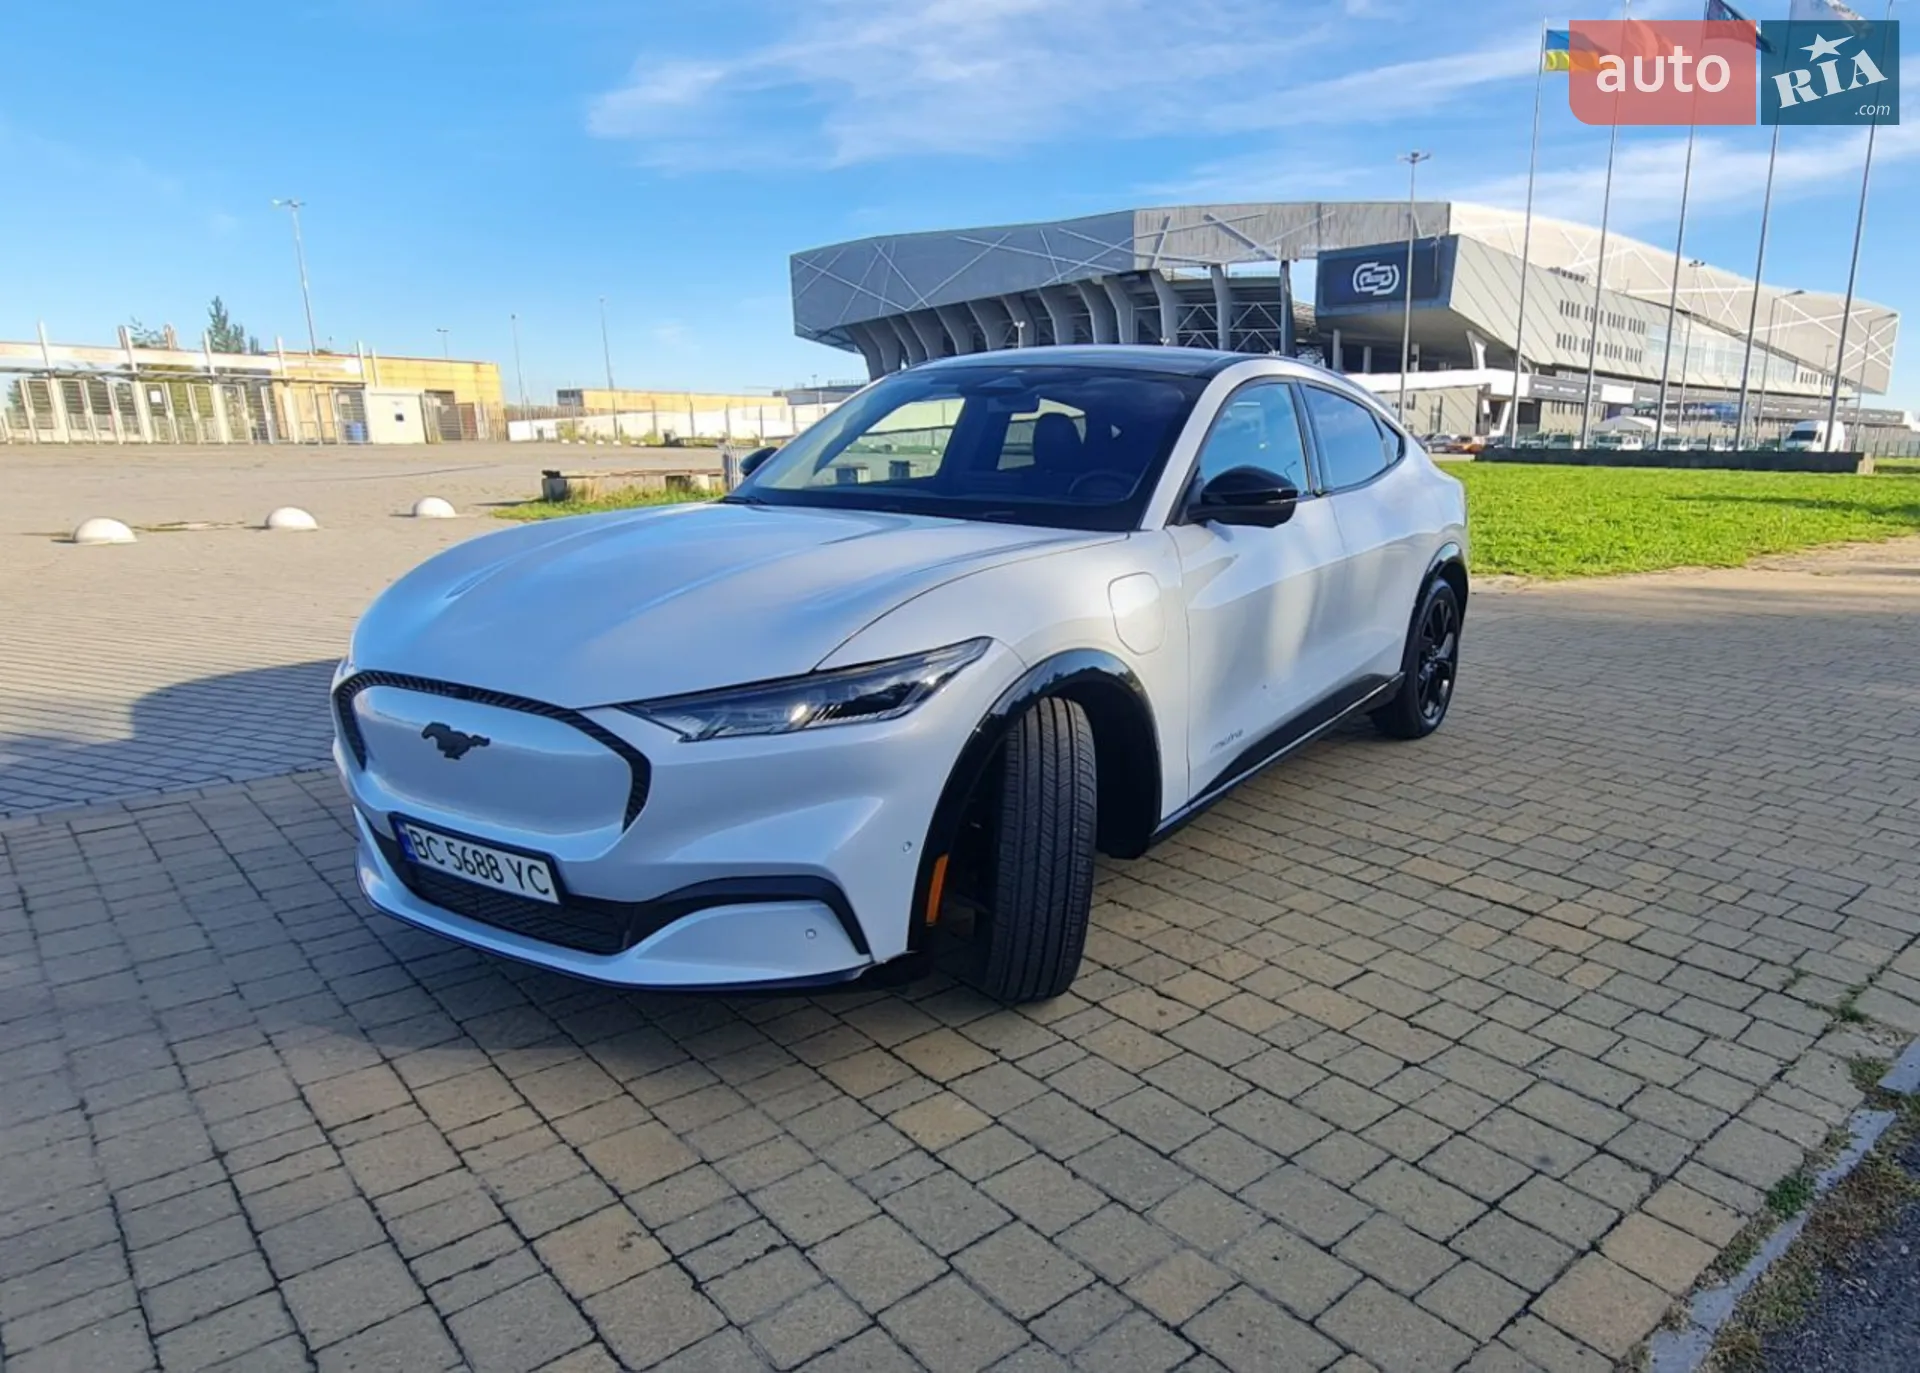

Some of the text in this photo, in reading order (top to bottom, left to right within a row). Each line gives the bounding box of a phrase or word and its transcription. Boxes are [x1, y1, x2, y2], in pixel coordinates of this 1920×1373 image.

[408, 829, 550, 895] BC 5688 YC
